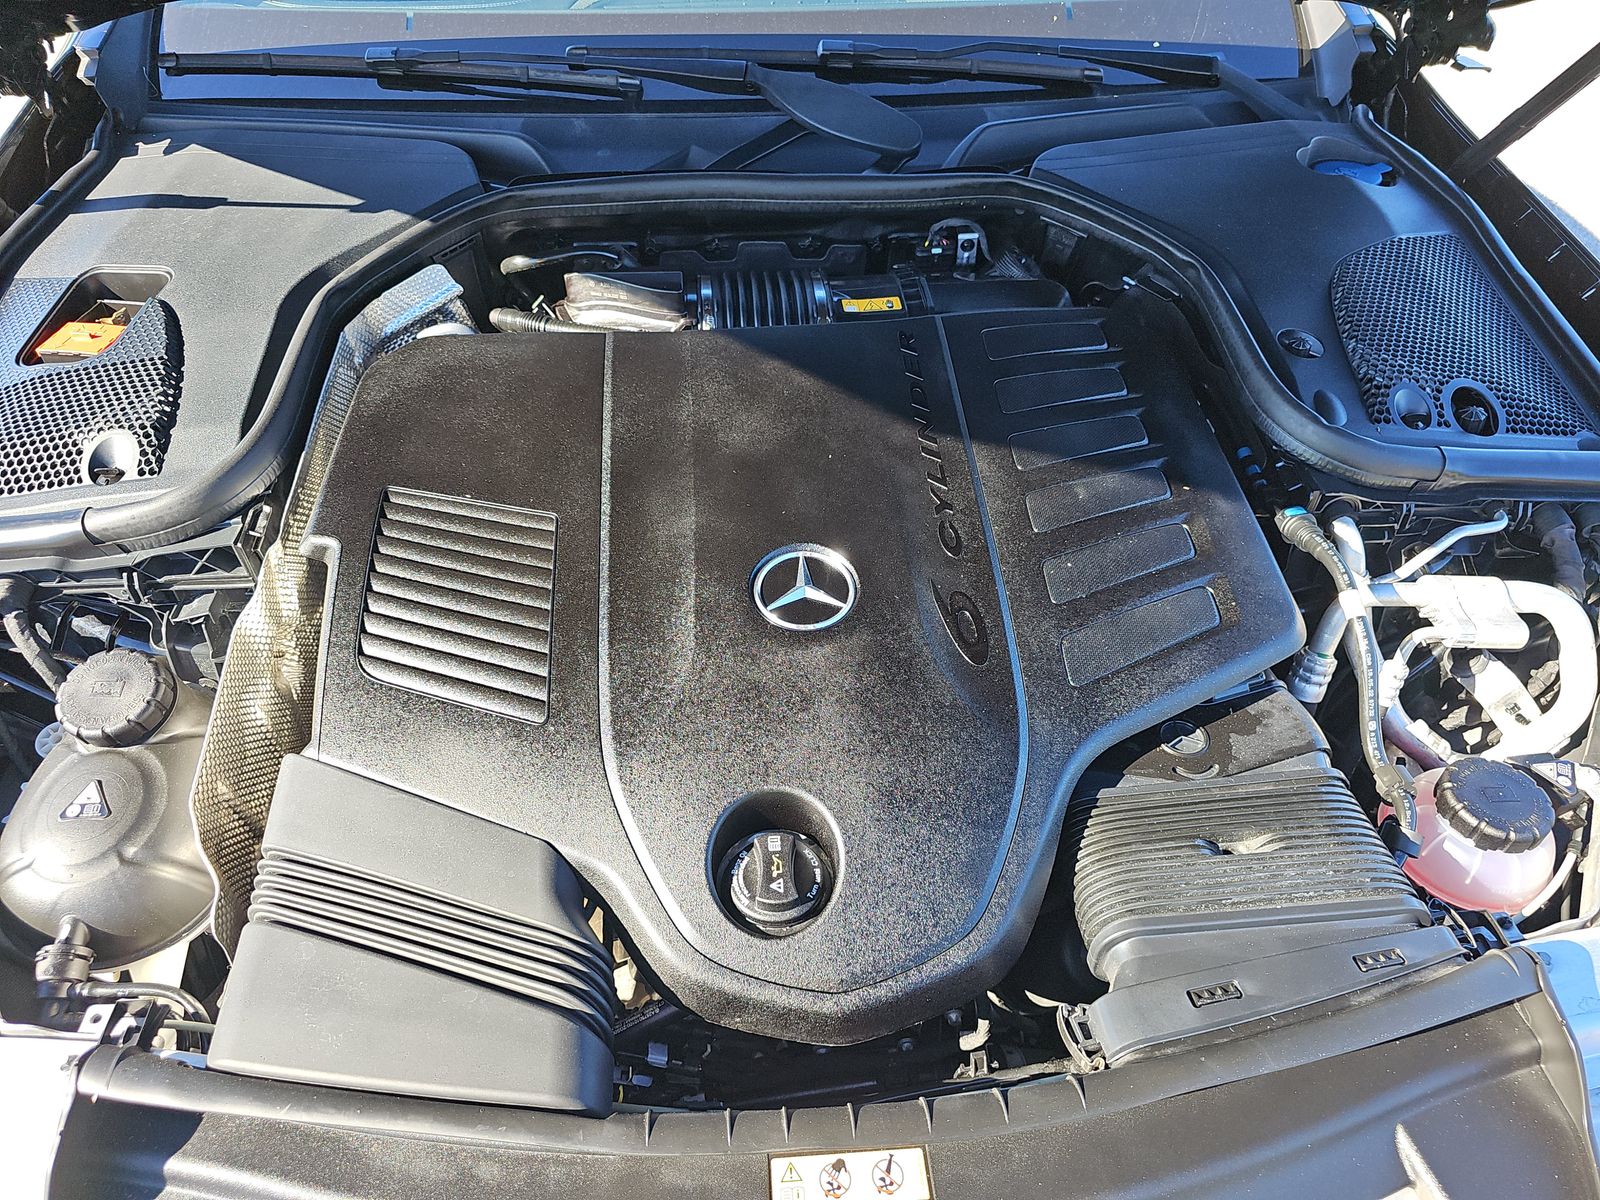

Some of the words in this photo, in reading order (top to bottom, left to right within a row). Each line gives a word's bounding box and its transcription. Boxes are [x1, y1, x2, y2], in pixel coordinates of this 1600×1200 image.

[898, 331, 963, 559] CYLINDER
[930, 578, 989, 666] 6
[806, 884, 819, 899] Turn
